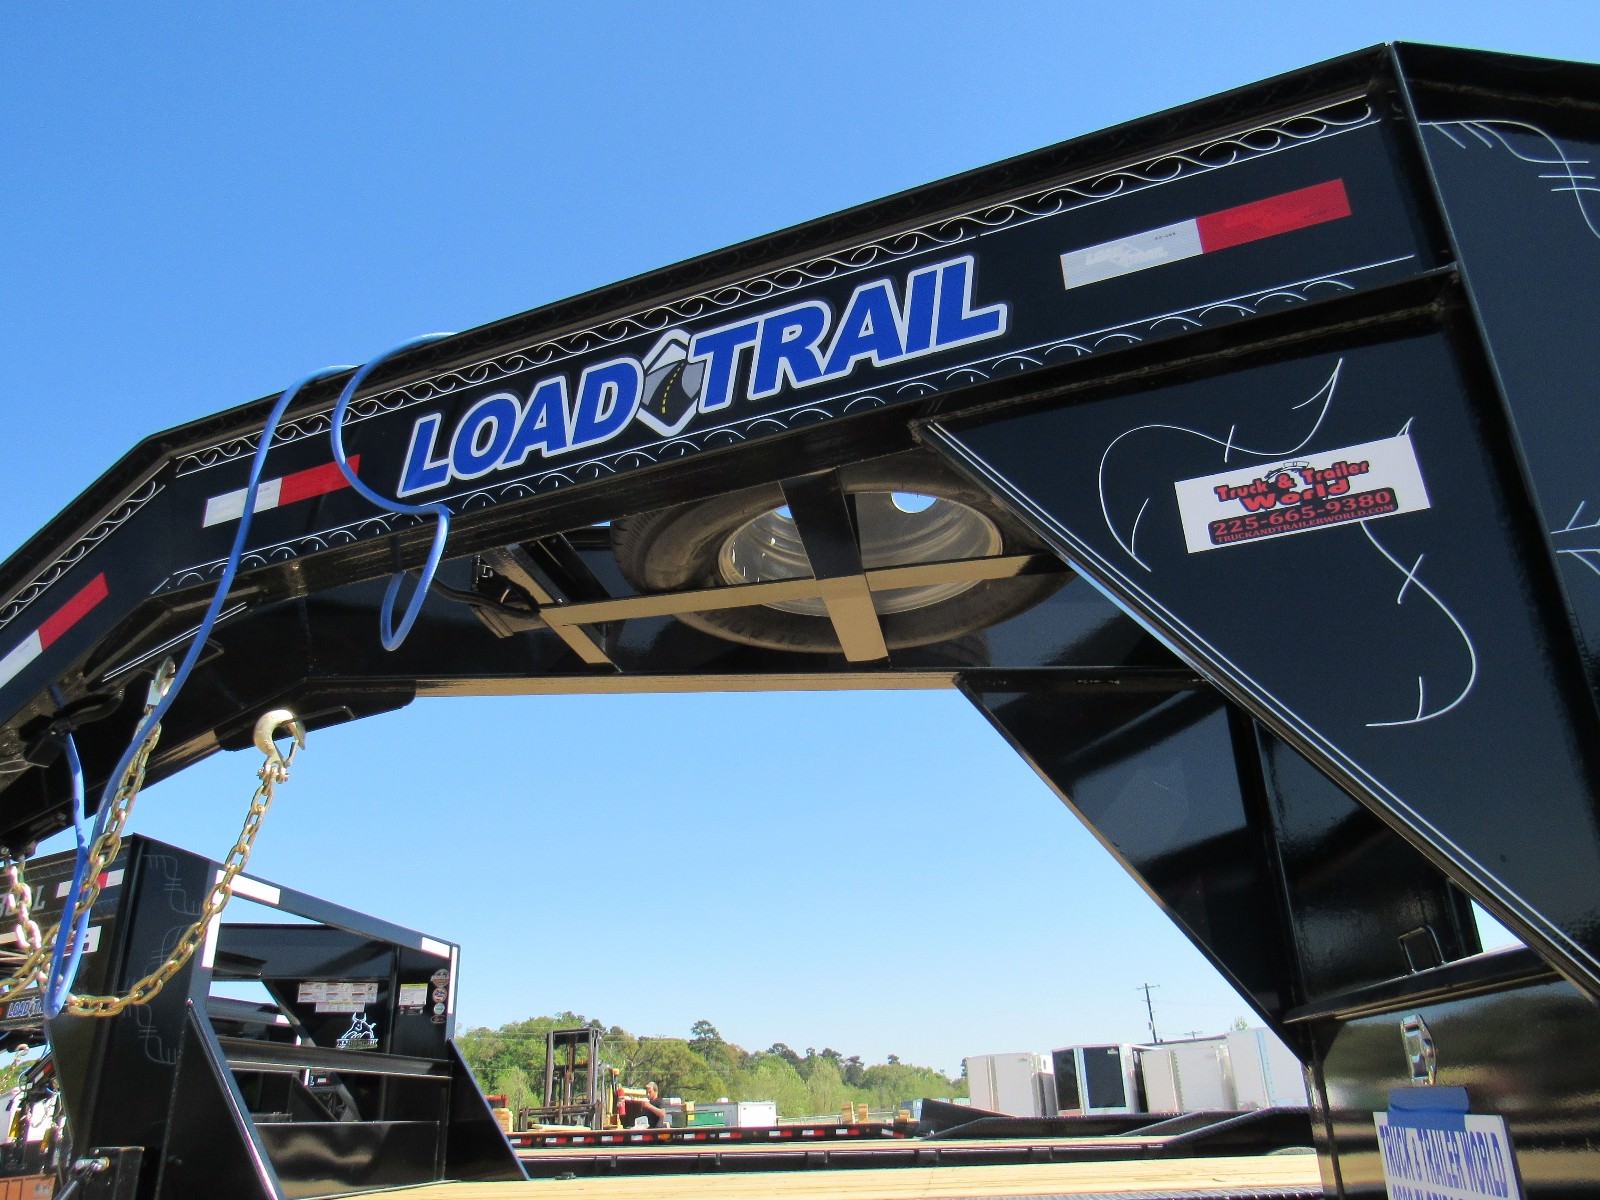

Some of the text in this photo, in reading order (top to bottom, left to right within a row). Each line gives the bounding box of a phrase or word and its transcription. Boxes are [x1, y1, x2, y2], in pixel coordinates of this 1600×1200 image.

[397, 255, 1008, 498] LOAD TRAIL
[1214, 460, 1370, 502] Truck & Trailer
[1240, 478, 1350, 512] World
[1213, 491, 1391, 536] 225-665-9380
[1216, 504, 1394, 542] TRUCKANDTRAILERWORLD.COM
[1379, 1126, 1415, 1181] TRUCK
[1415, 1127, 1467, 1190] TRAILER
[1460, 1131, 1509, 1198] WORLD
